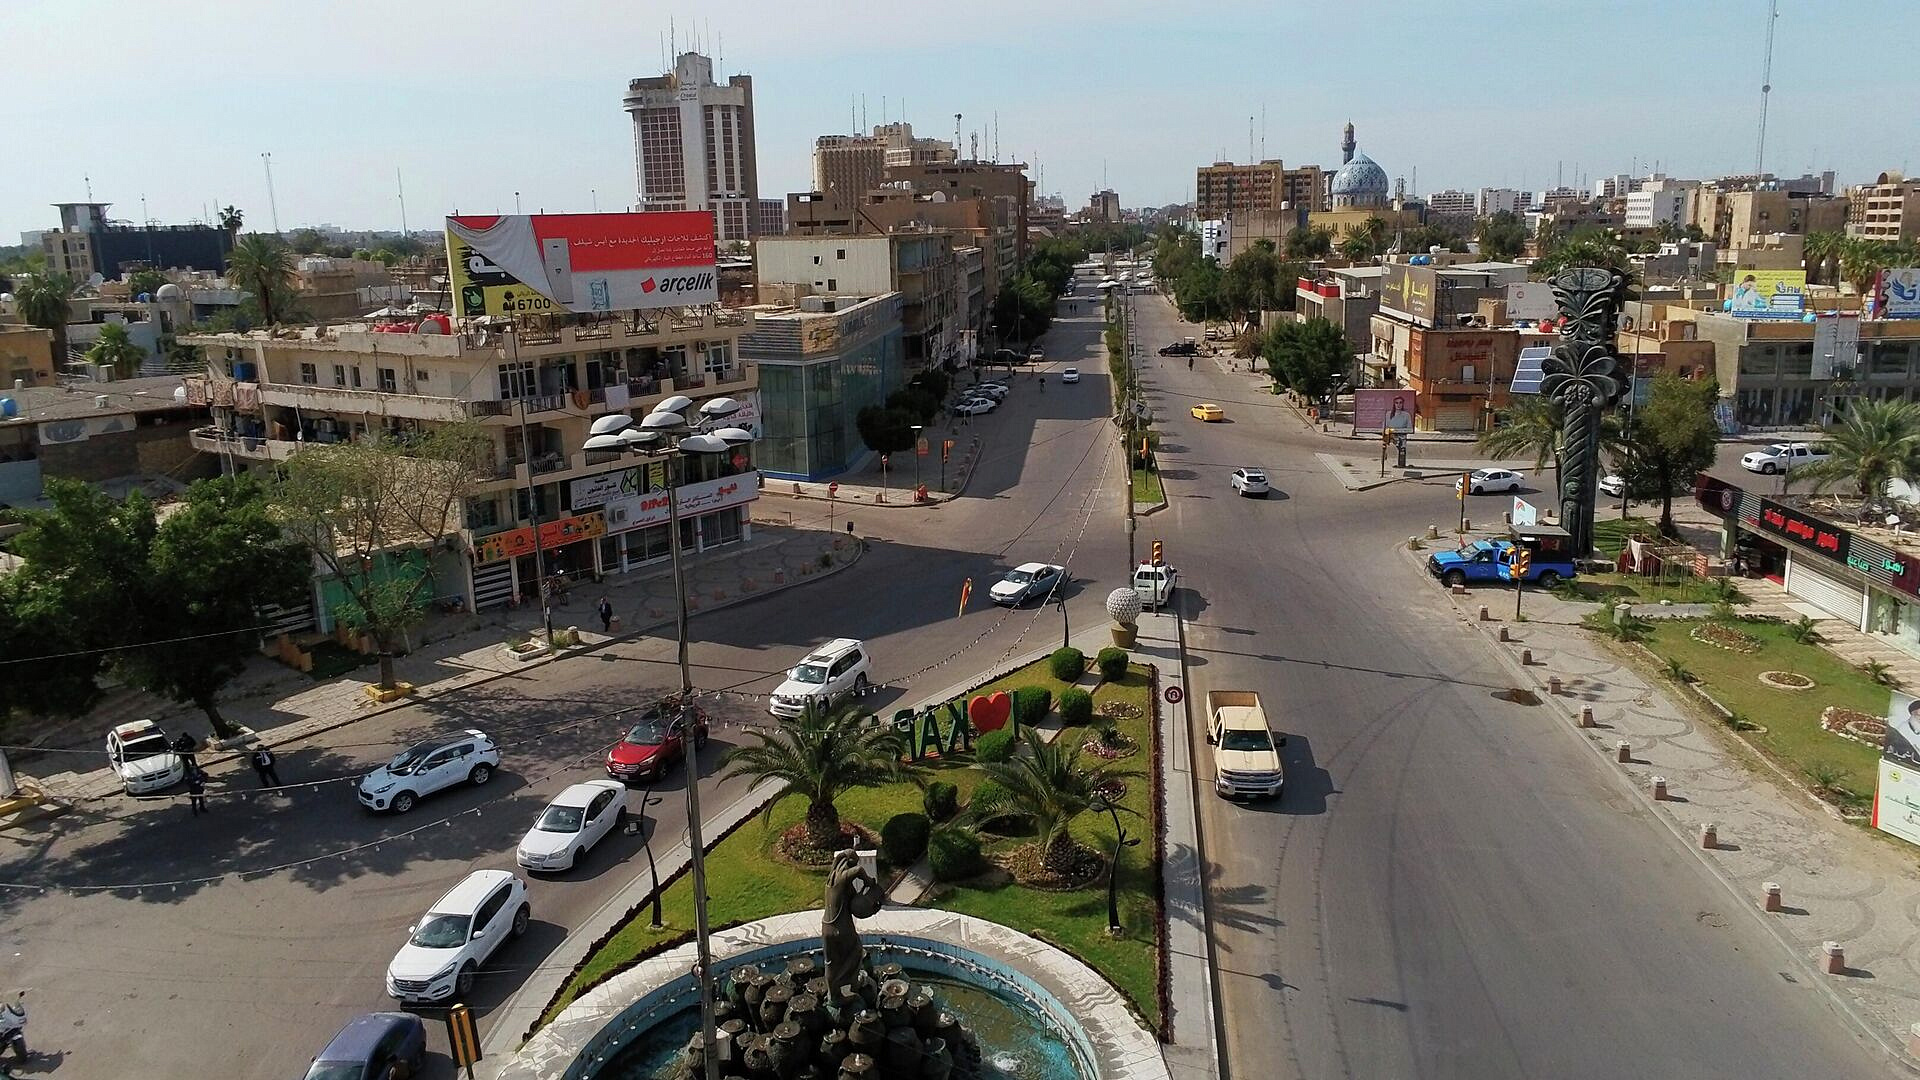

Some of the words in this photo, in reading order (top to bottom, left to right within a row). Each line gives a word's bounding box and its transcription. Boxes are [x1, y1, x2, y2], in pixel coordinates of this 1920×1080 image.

[608, 239, 617, 248] مع
[660, 272, 714, 296] arçelik
[517, 297, 551, 311] 6700
[1881, 557, 1905, 576] زهور
